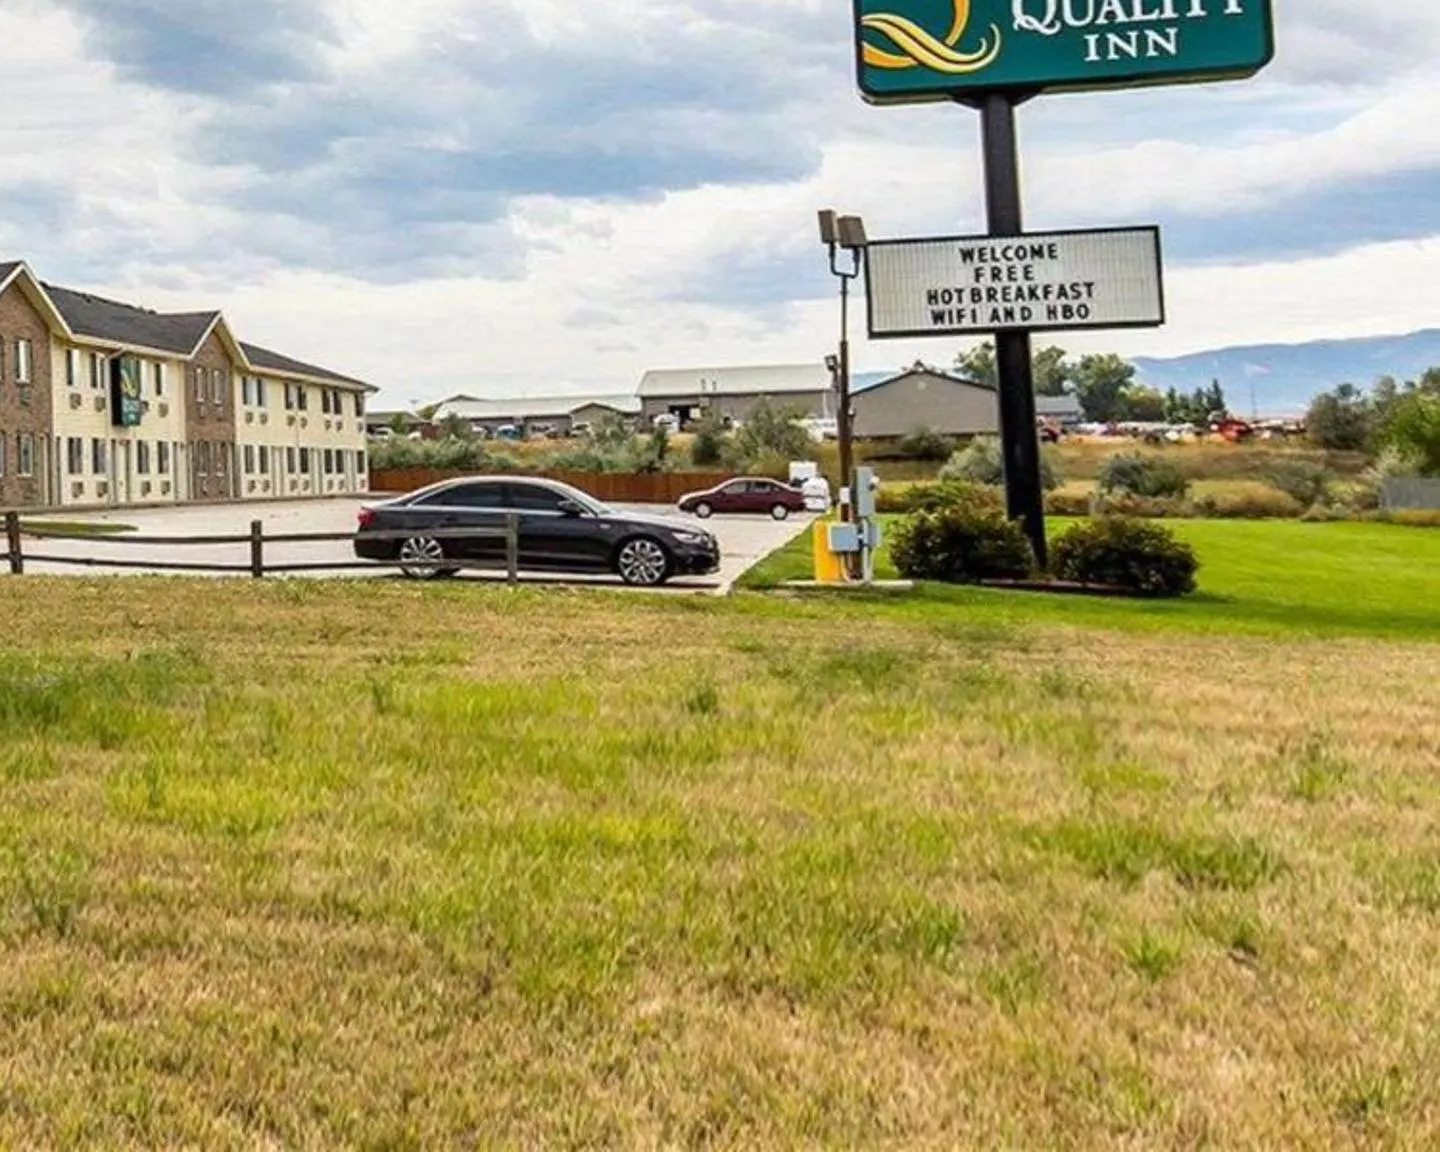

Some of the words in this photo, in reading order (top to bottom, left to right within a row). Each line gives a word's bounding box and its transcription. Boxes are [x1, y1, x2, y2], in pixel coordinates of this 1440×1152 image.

[1084, 28, 1178, 61] INN
[960, 243, 1058, 264] WELCOME
[974, 264, 1035, 283] FREE
[927, 288, 965, 306] HOT
[970, 282, 1095, 303] BREAKFAST
[931, 307, 977, 325] WIFI
[990, 306, 1032, 323] AND
[1047, 303, 1090, 320] HBO
